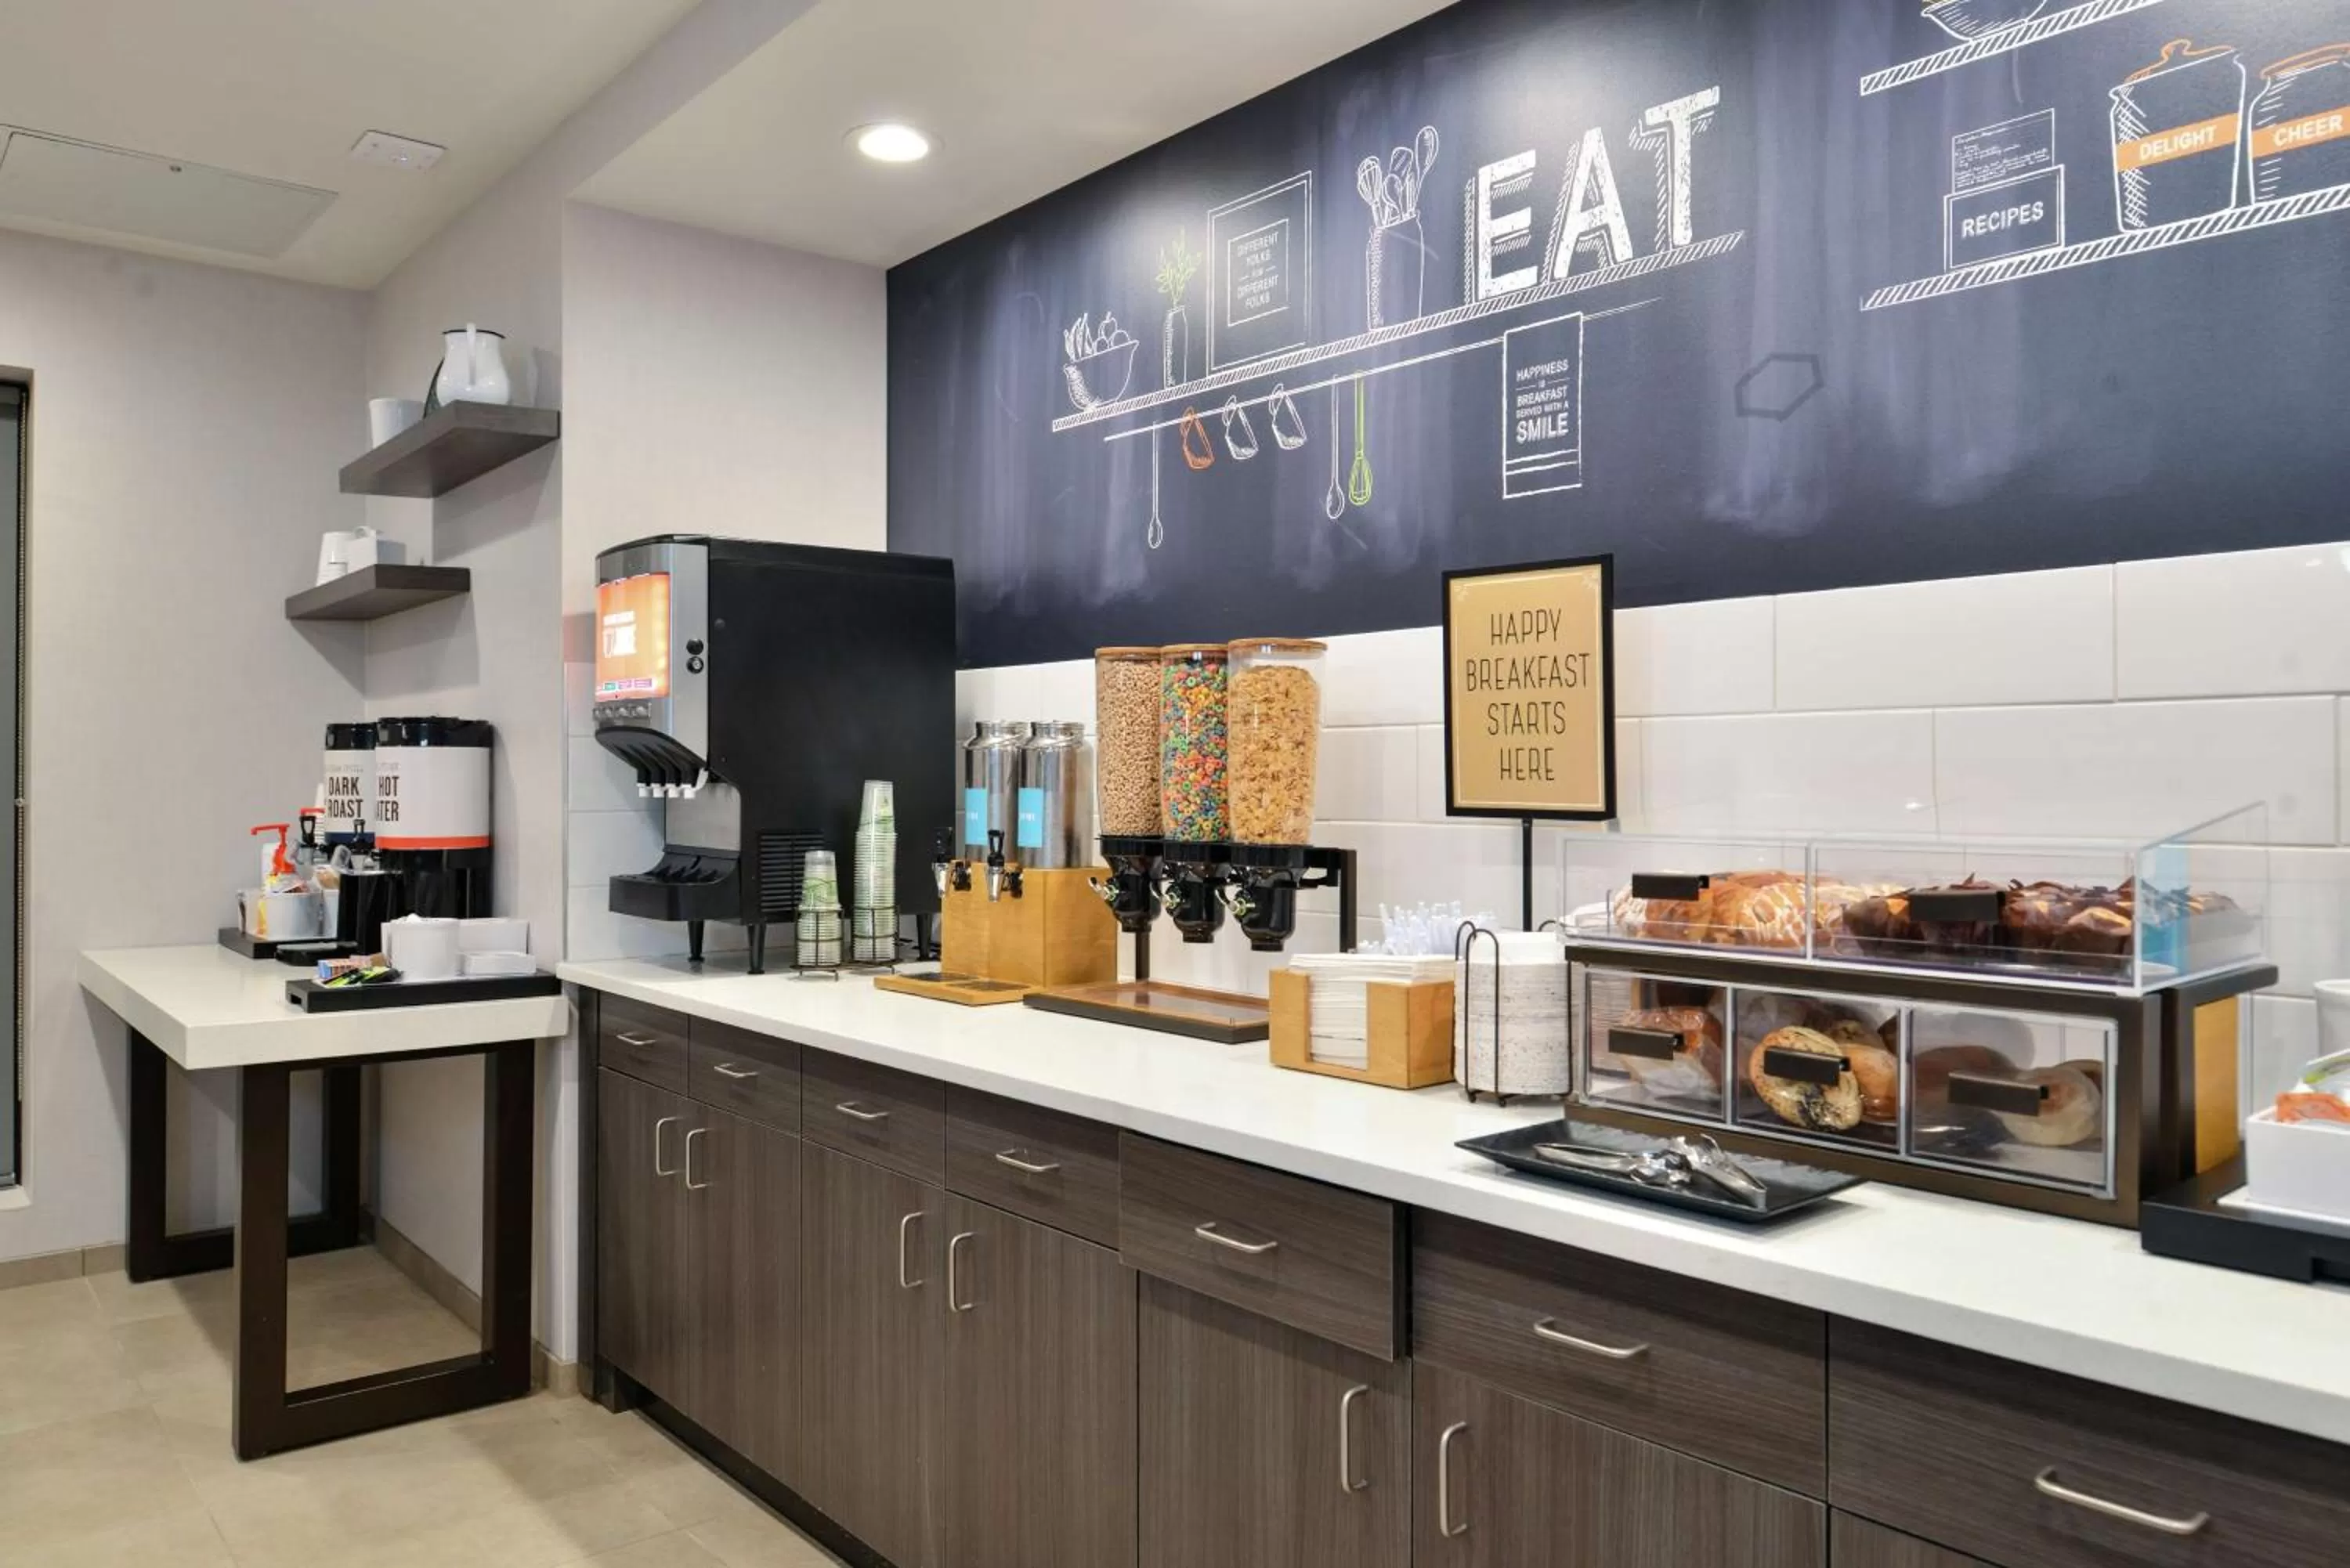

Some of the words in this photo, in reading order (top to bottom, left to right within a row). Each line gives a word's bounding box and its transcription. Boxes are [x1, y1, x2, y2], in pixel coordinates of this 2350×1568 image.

[2139, 125, 2217, 161] DELIGHT
[2273, 114, 2344, 147] CHEER
[1464, 85, 1720, 303] EAT
[1961, 201, 2044, 238] RECIPES
[1237, 231, 1279, 258] DIFFERENT
[1237, 274, 1279, 300] DIFFERENT
[1516, 359, 1568, 381] HAPPINESS
[1516, 405, 1542, 419] SERVED
[1544, 402, 1562, 412] WITH
[1563, 400, 1569, 411] A
[1517, 385, 1567, 406] BREAKFAST
[1516, 412, 1569, 444] SMILE
[1491, 608, 1561, 645] HAPPY
[1466, 652, 1590, 692] BREAKFAST
[1488, 700, 1567, 735] STARTS
[1499, 746, 1555, 781] HERE
[329, 776, 360, 796] DARK
[378, 776, 399, 796] HOT
[327, 798, 363, 818] ROAST
